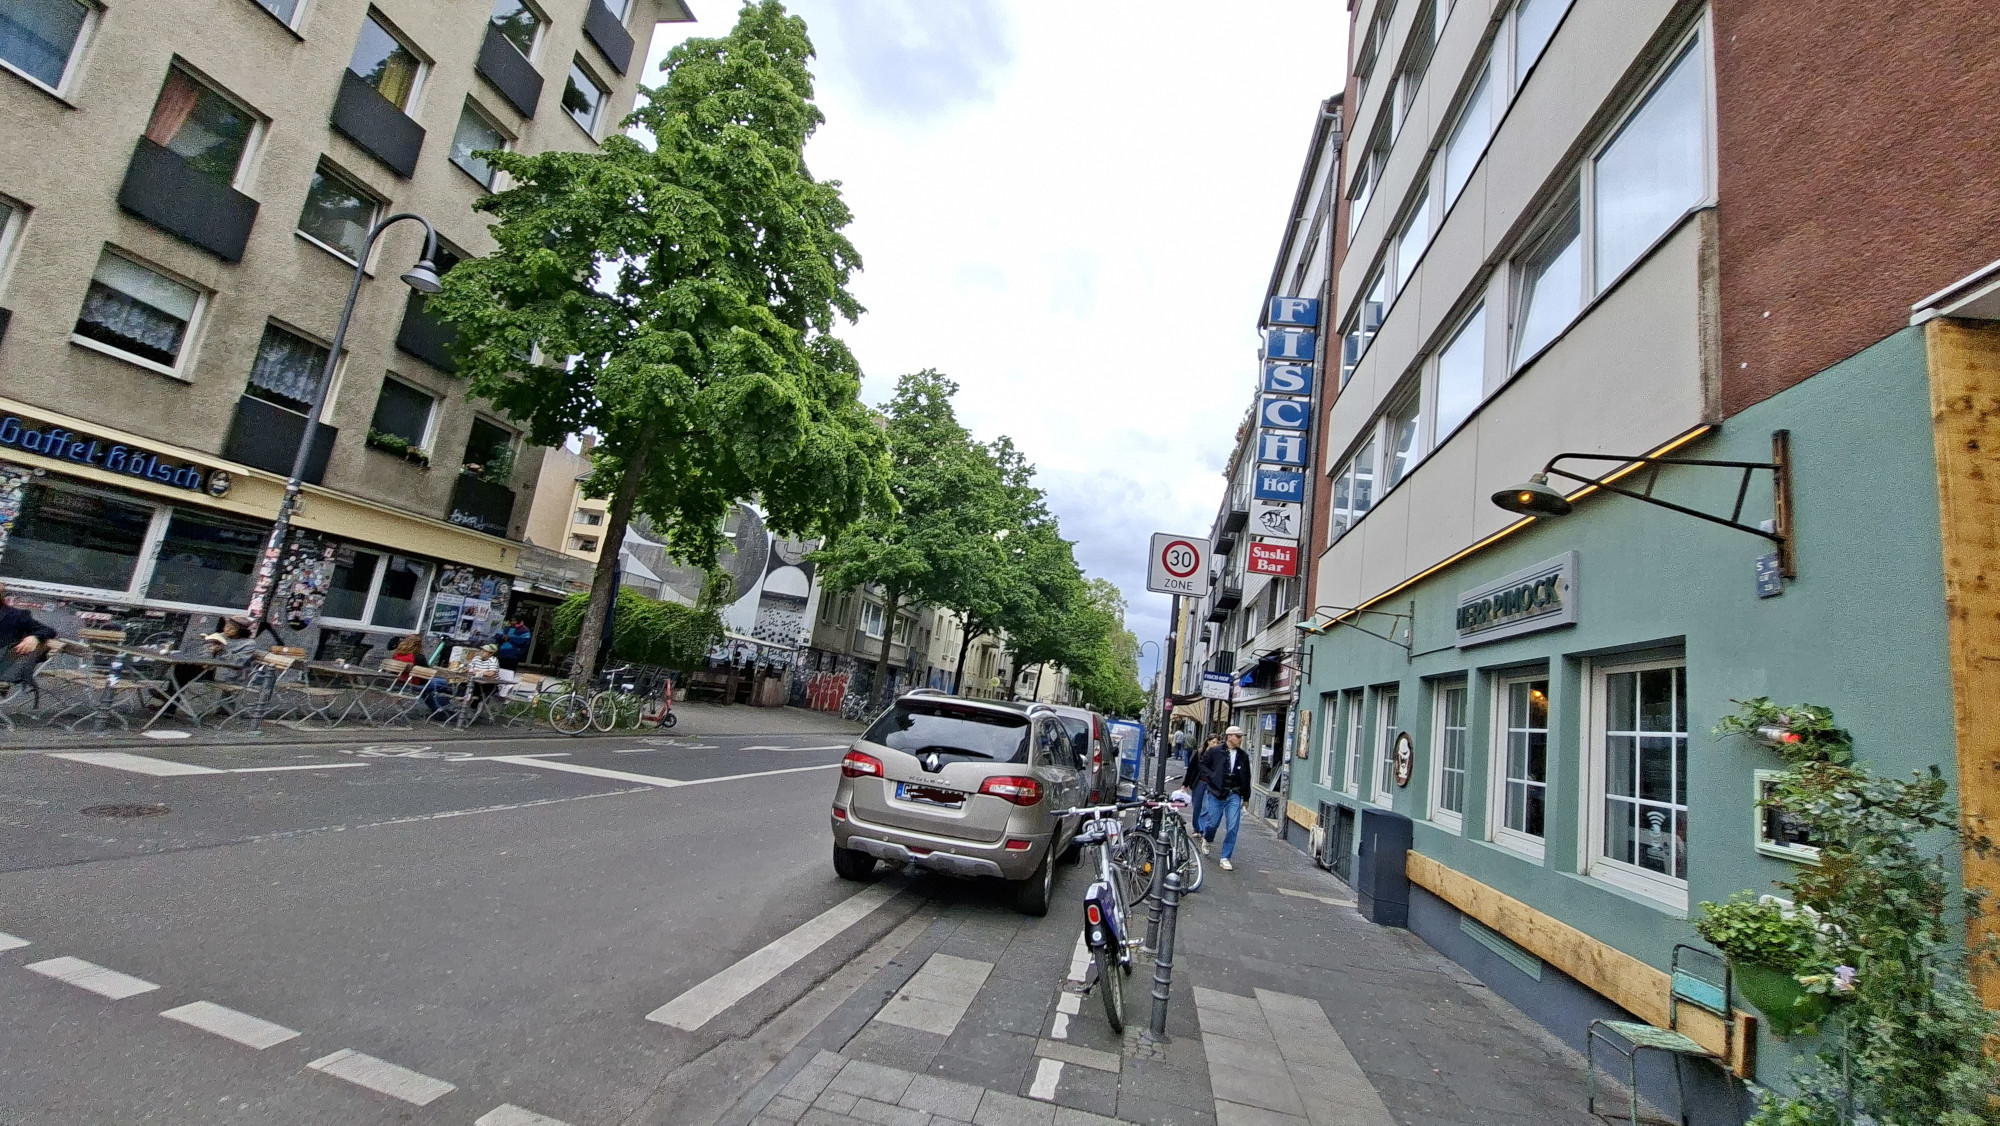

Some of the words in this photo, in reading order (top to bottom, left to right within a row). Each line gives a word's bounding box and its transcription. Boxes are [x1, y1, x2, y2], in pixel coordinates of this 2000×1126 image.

[1261, 298, 1310, 463] FISCH
[1263, 477, 1300, 493] Hof
[1170, 550, 1192, 568] 30
[1252, 546, 1291, 562] Sushi
[1257, 558, 1285, 573] Bar
[1164, 578, 1194, 591] ZONE
[1456, 599, 1492, 630] HERR
[1493, 573, 1560, 620] PIMOCK
